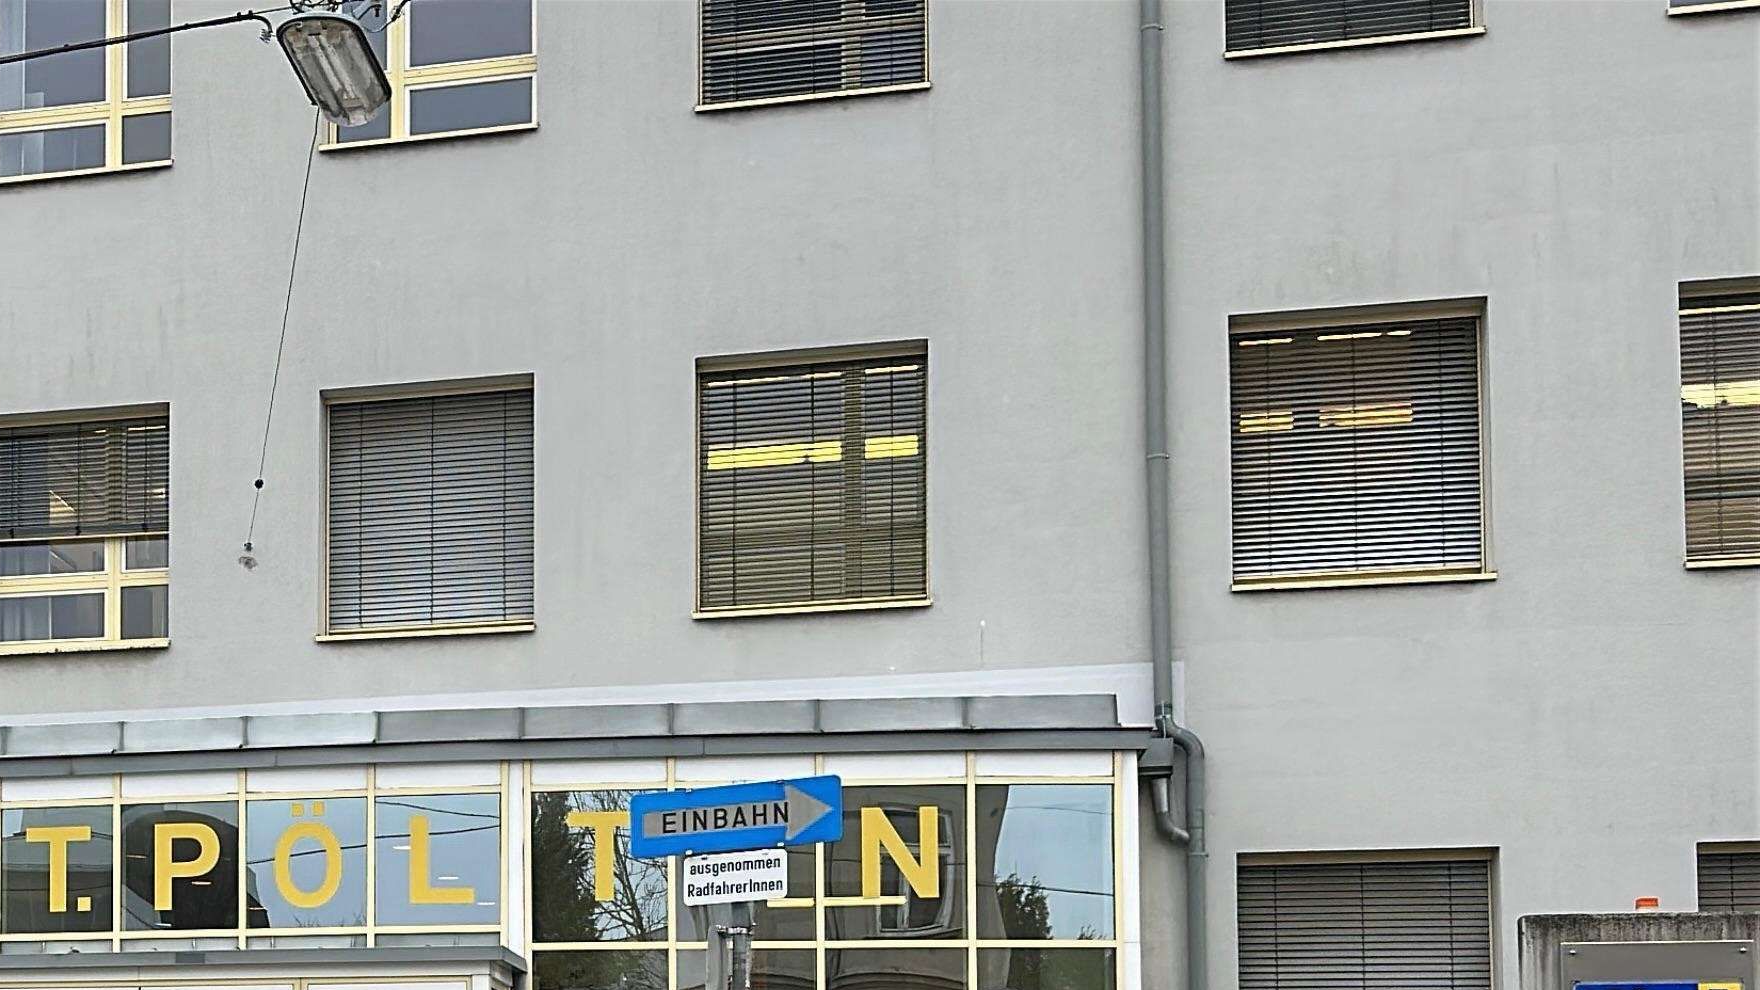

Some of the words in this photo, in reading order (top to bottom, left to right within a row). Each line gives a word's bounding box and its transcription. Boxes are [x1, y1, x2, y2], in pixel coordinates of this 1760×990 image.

[662, 801, 789, 834] EINBAHN
[154, 801, 940, 911] PÖLTN
[689, 857, 781, 876] ausgenommen
[687, 878, 783, 898] RadfahrerInnen
